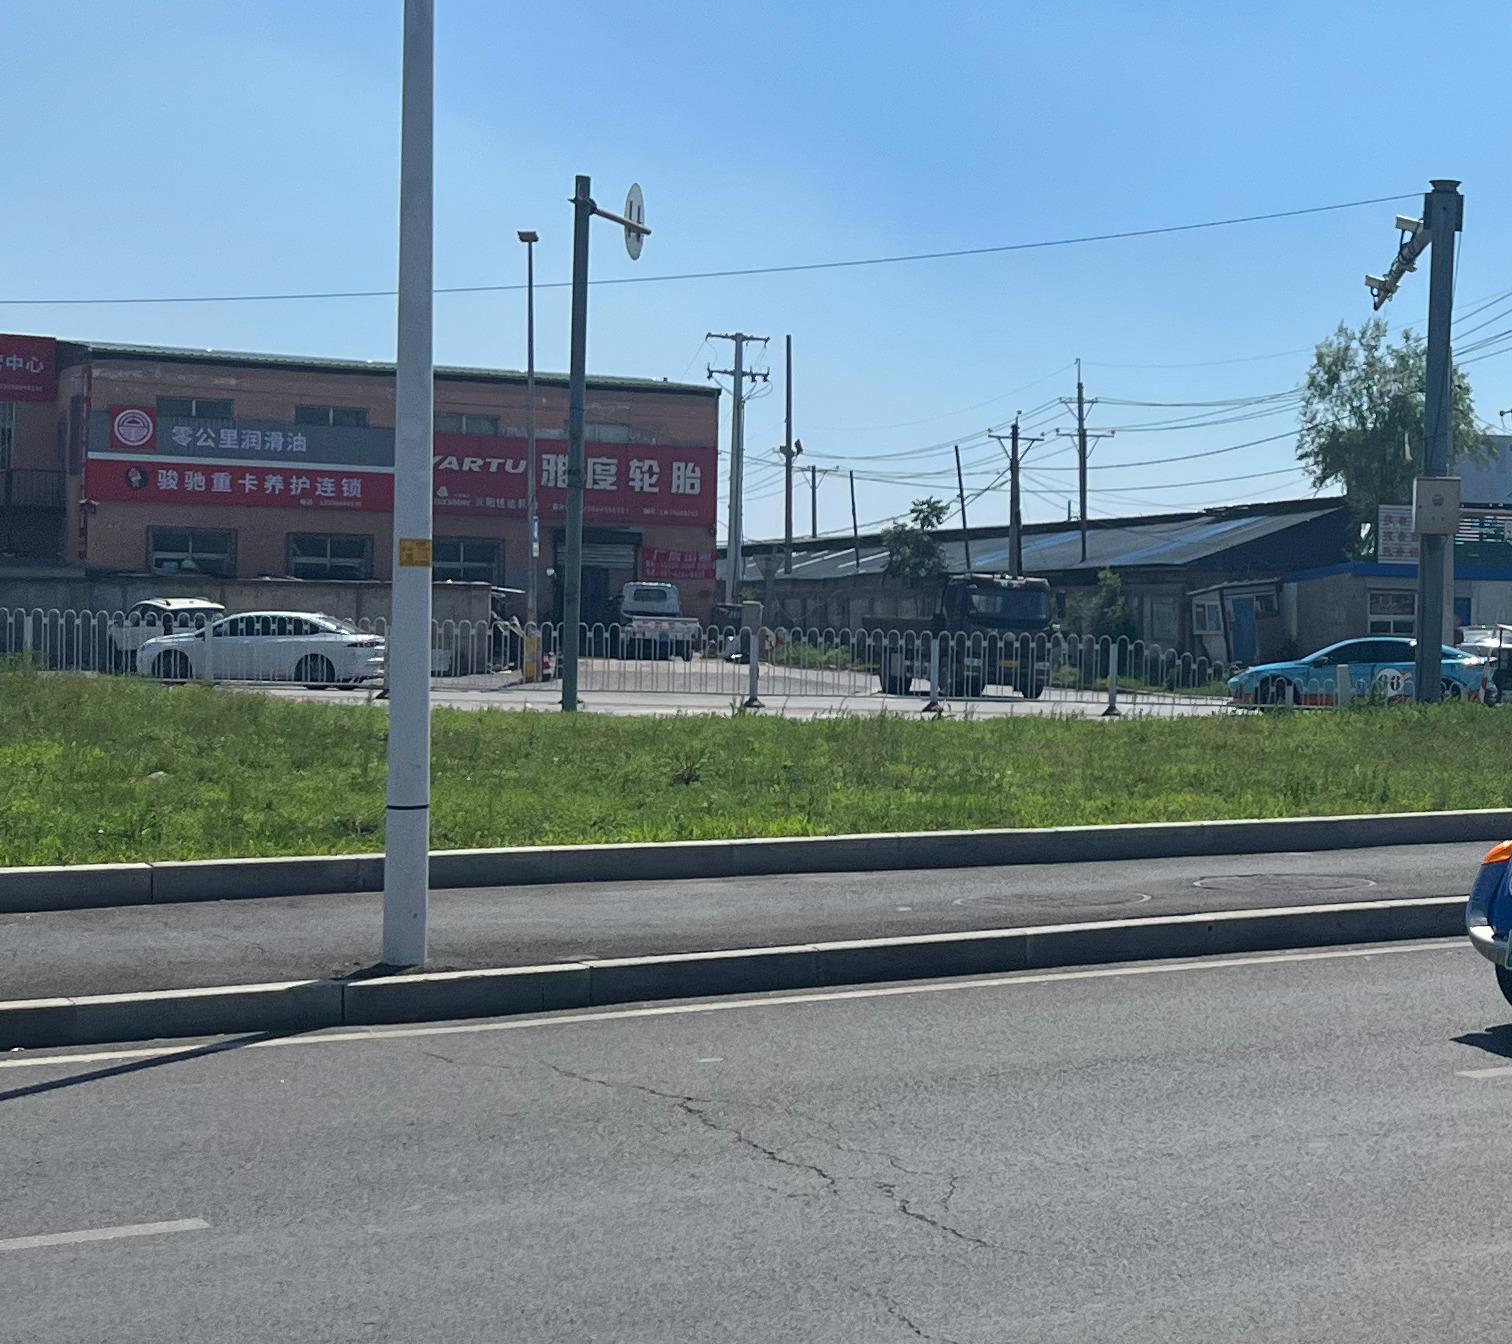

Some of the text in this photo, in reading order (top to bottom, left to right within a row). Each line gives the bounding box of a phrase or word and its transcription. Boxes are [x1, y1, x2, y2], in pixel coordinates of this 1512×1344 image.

[171, 425, 307, 453] 零公里润滑油
[156, 468, 363, 498] 骏驰重卡养护连锁
[540, 453, 701, 495] 雅度轮胎
